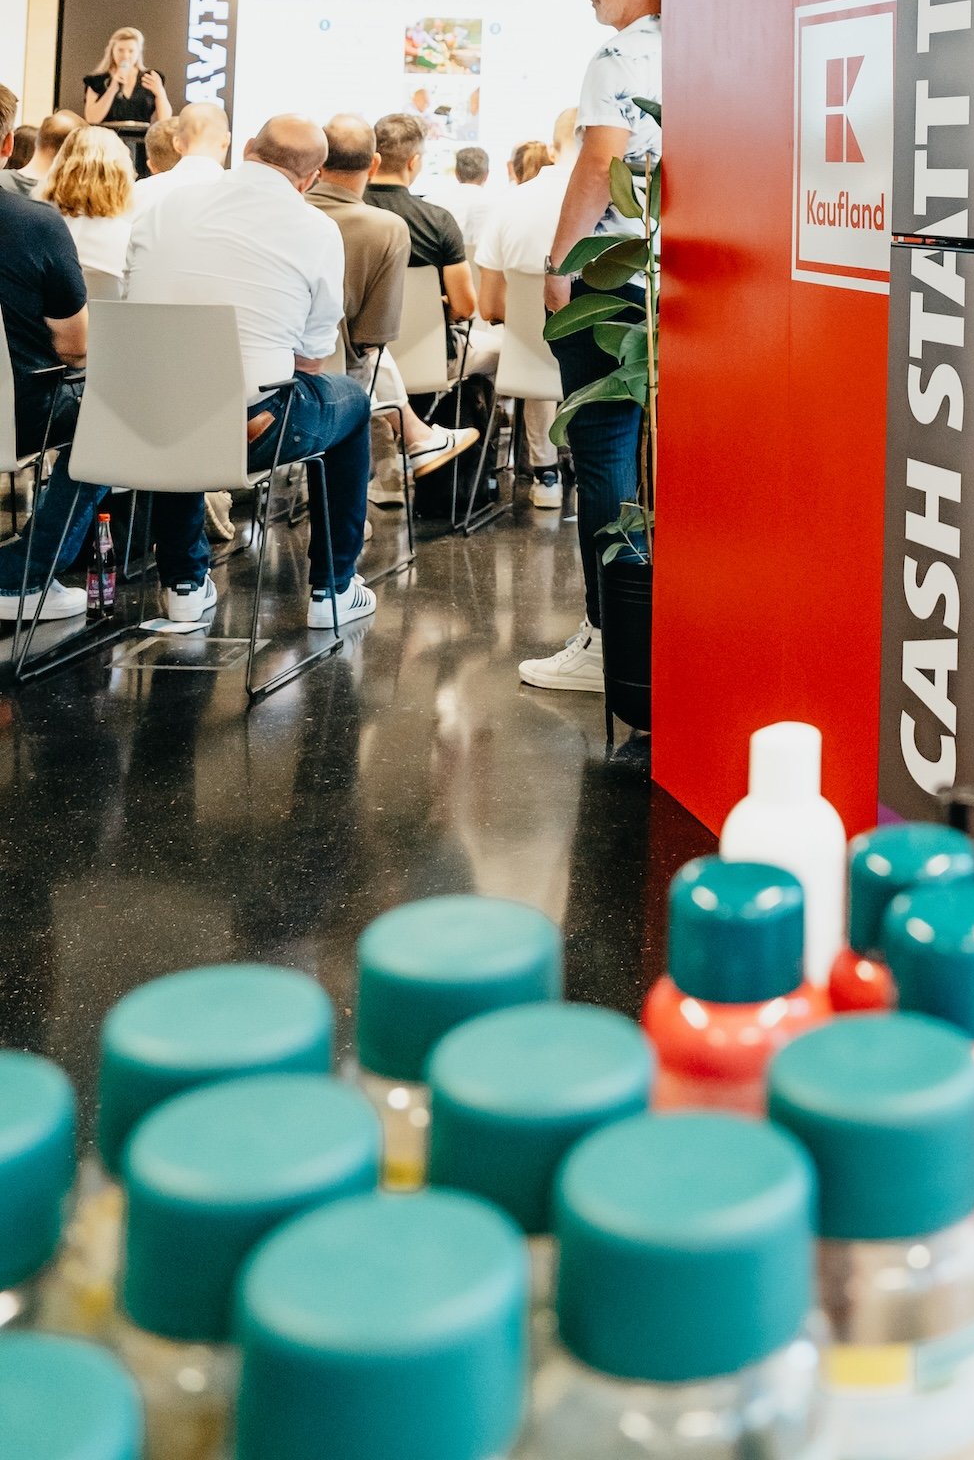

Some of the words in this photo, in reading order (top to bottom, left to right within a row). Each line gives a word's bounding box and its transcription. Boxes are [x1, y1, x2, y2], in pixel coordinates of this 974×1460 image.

[806, 188, 886, 232] Kaufland
[907, 80, 971, 432] STATT
[901, 458, 962, 796] CASH
